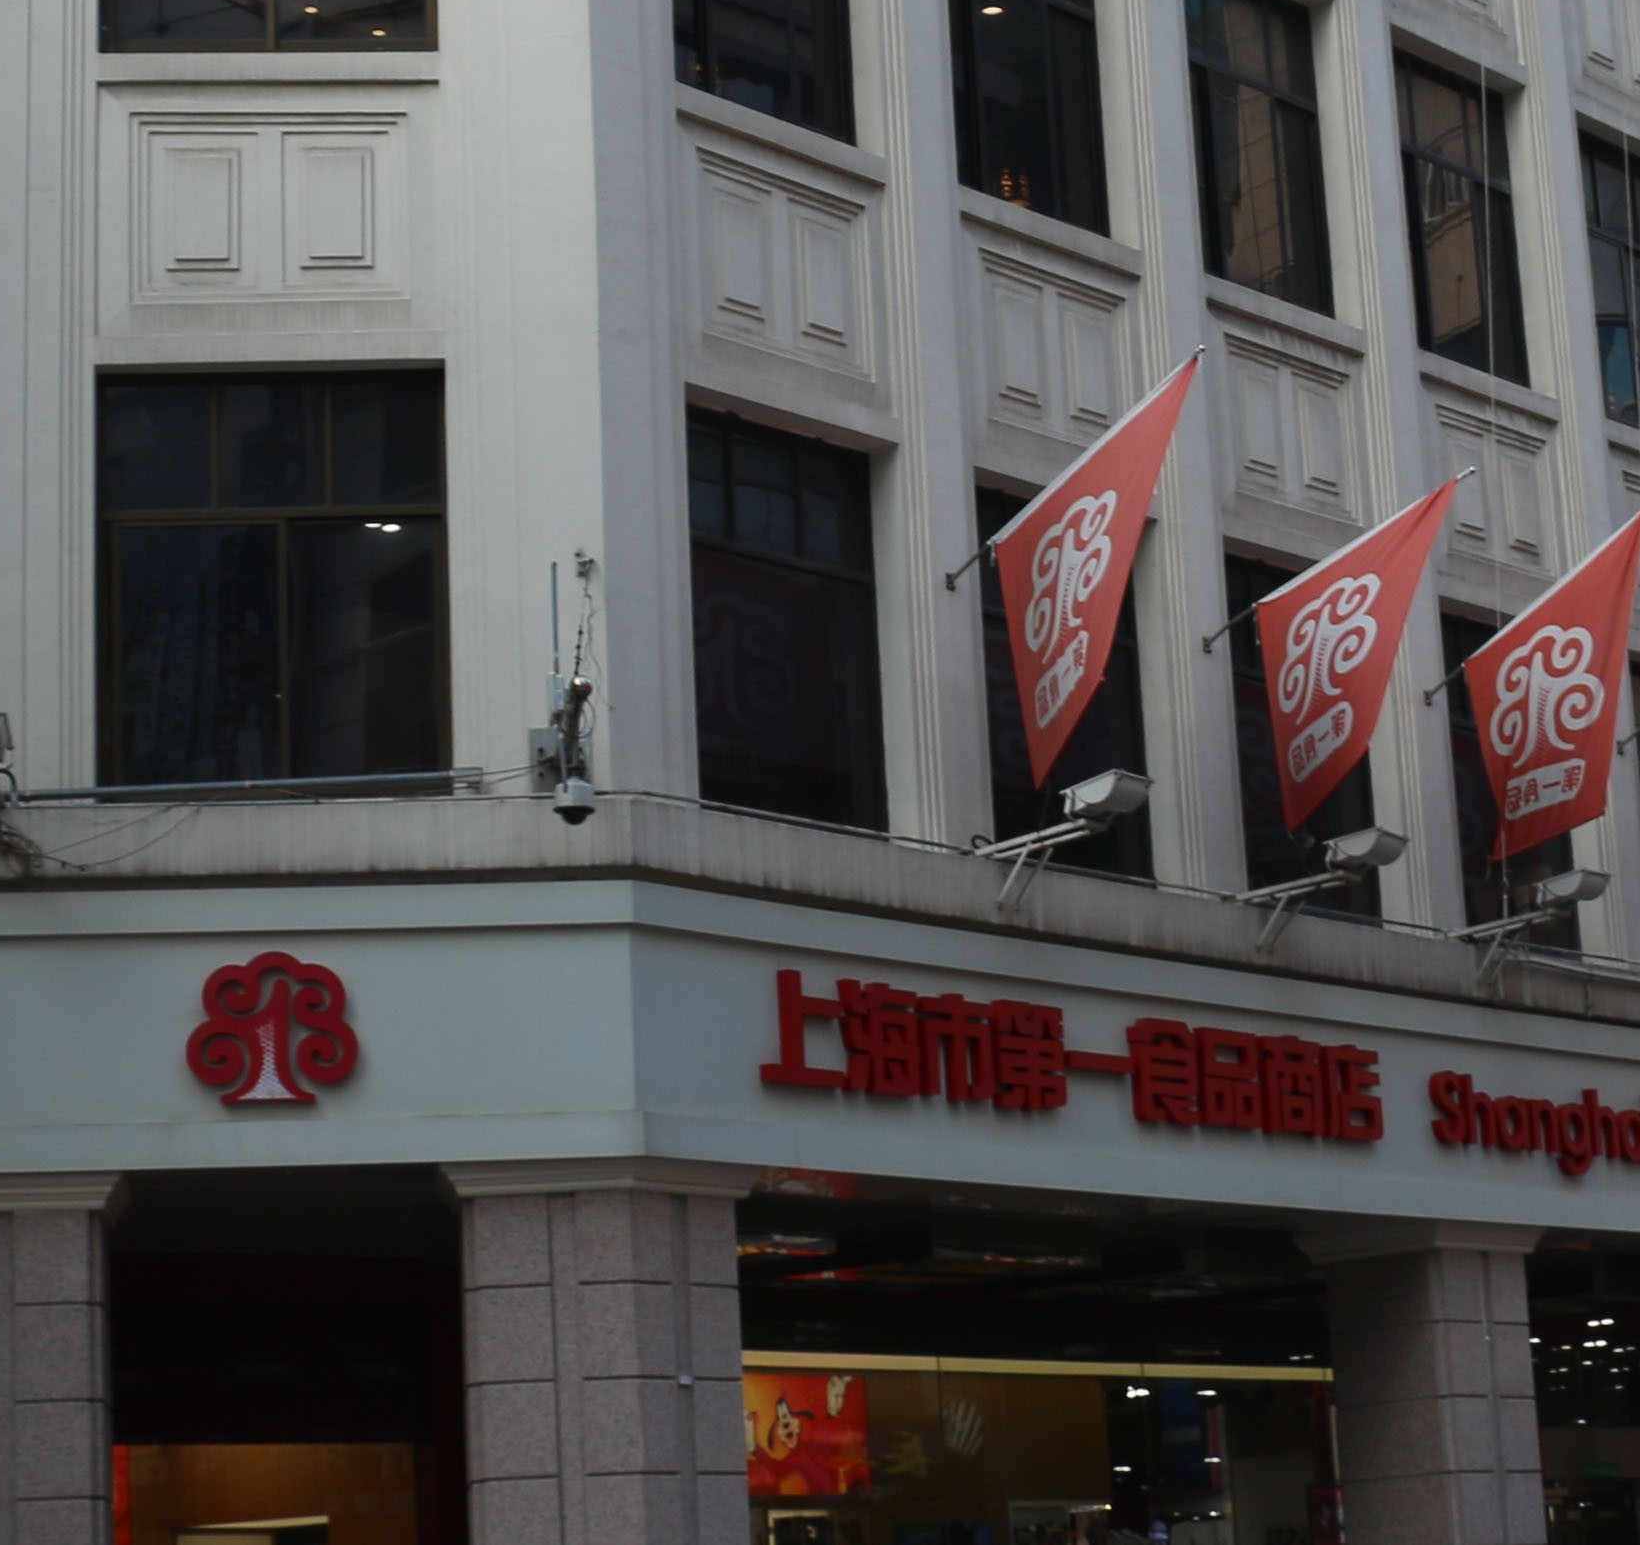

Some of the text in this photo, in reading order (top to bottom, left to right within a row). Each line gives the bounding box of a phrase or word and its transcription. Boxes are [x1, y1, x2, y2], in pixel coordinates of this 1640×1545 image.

[759, 969, 1384, 1143] 上海市第一食品商店
